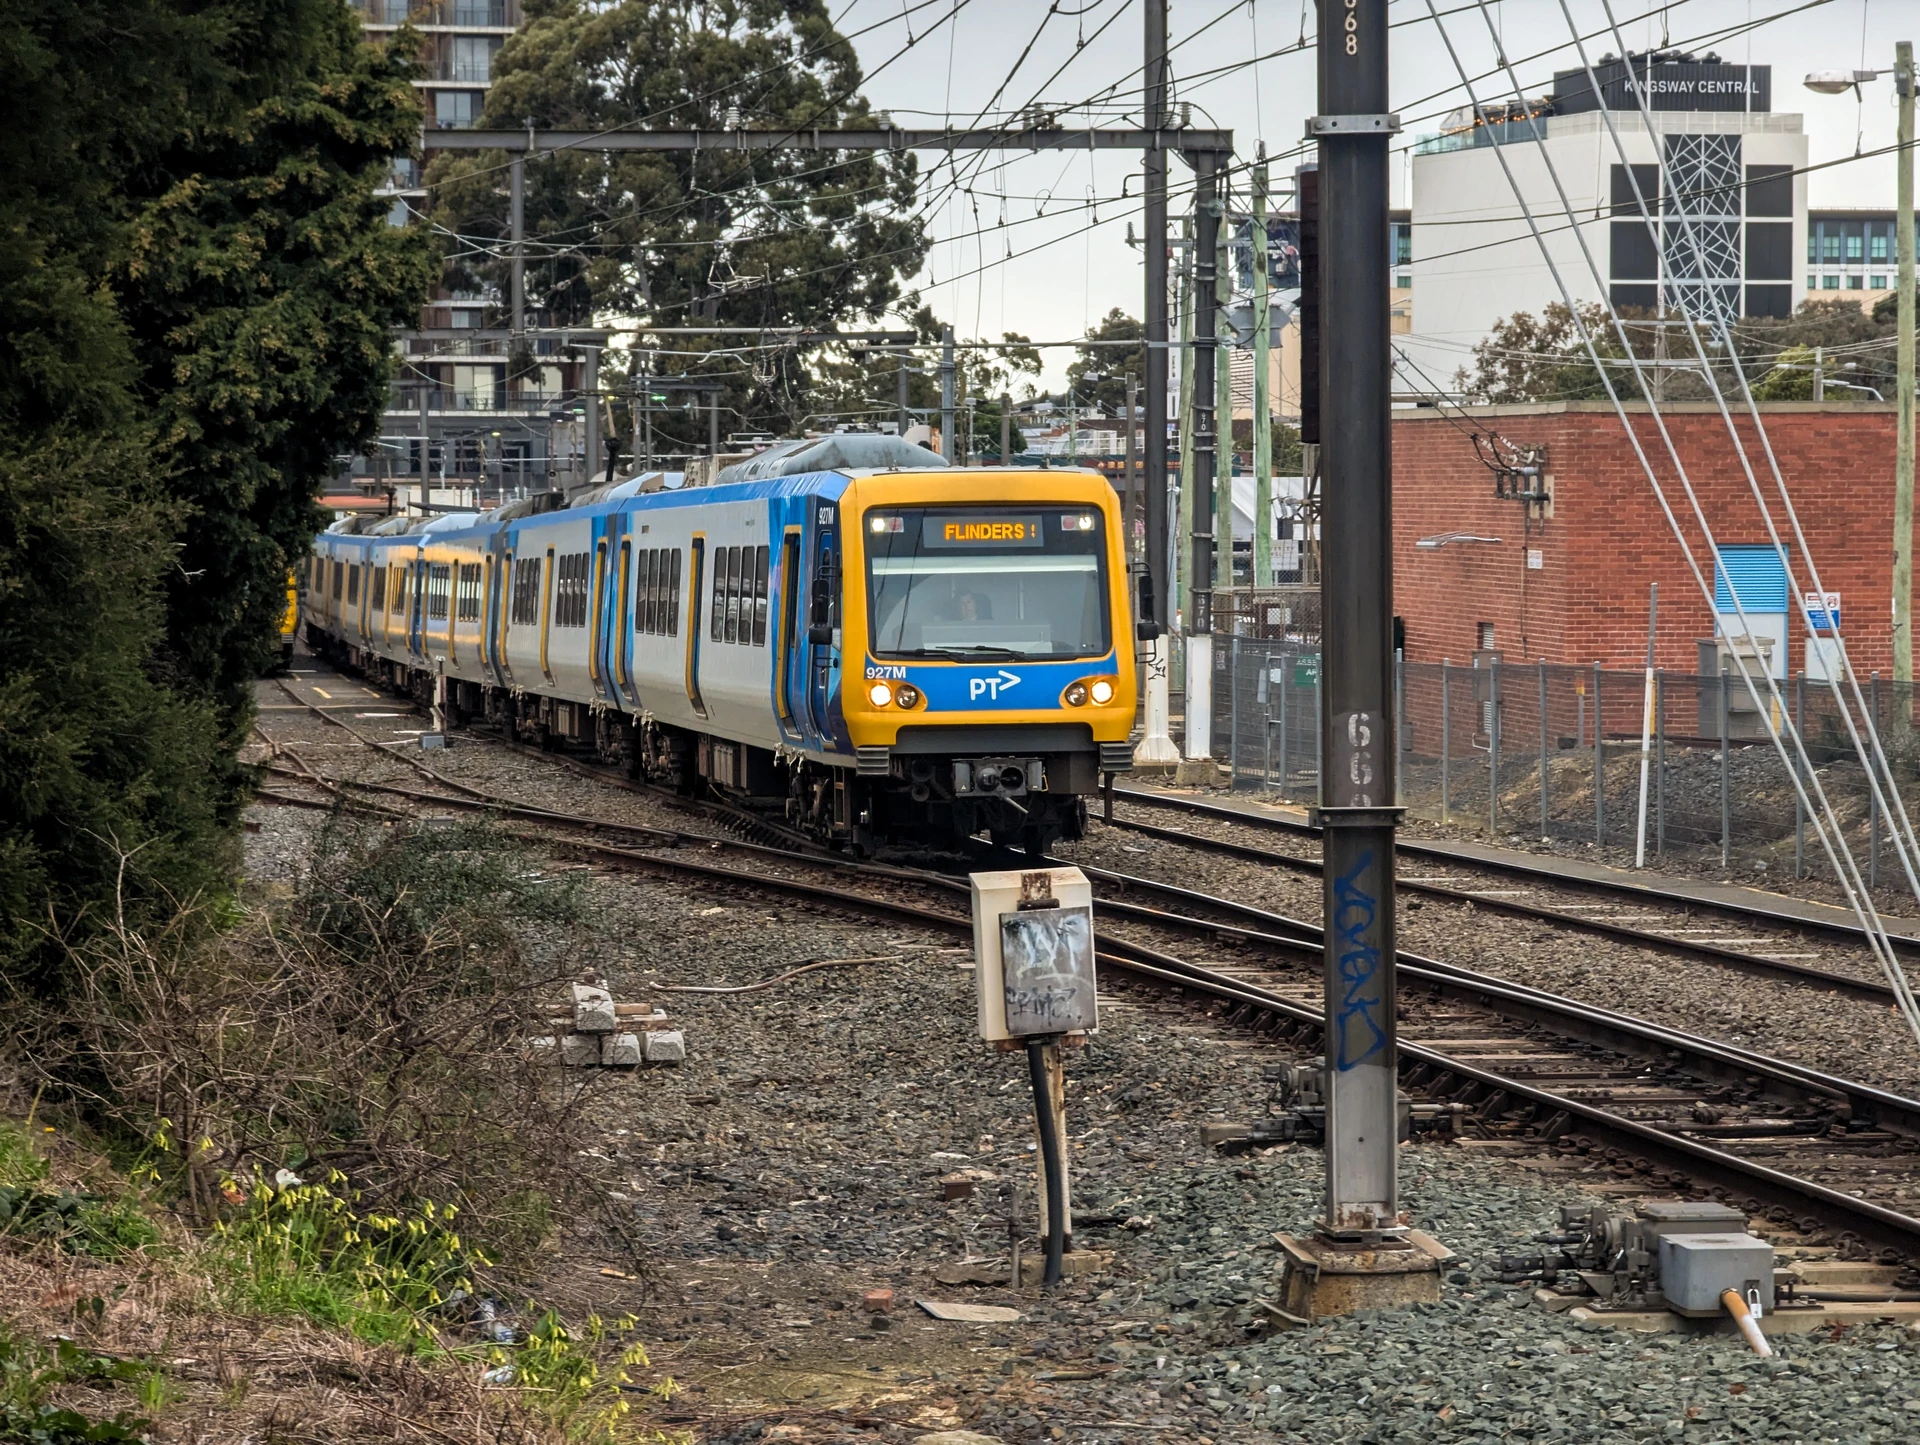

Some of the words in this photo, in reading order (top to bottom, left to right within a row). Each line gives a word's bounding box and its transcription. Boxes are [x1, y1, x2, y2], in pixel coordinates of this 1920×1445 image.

[818, 506, 835, 525] 927M
[944, 523, 1025, 540] FLINDERS
[866, 667, 907, 679] 927M
